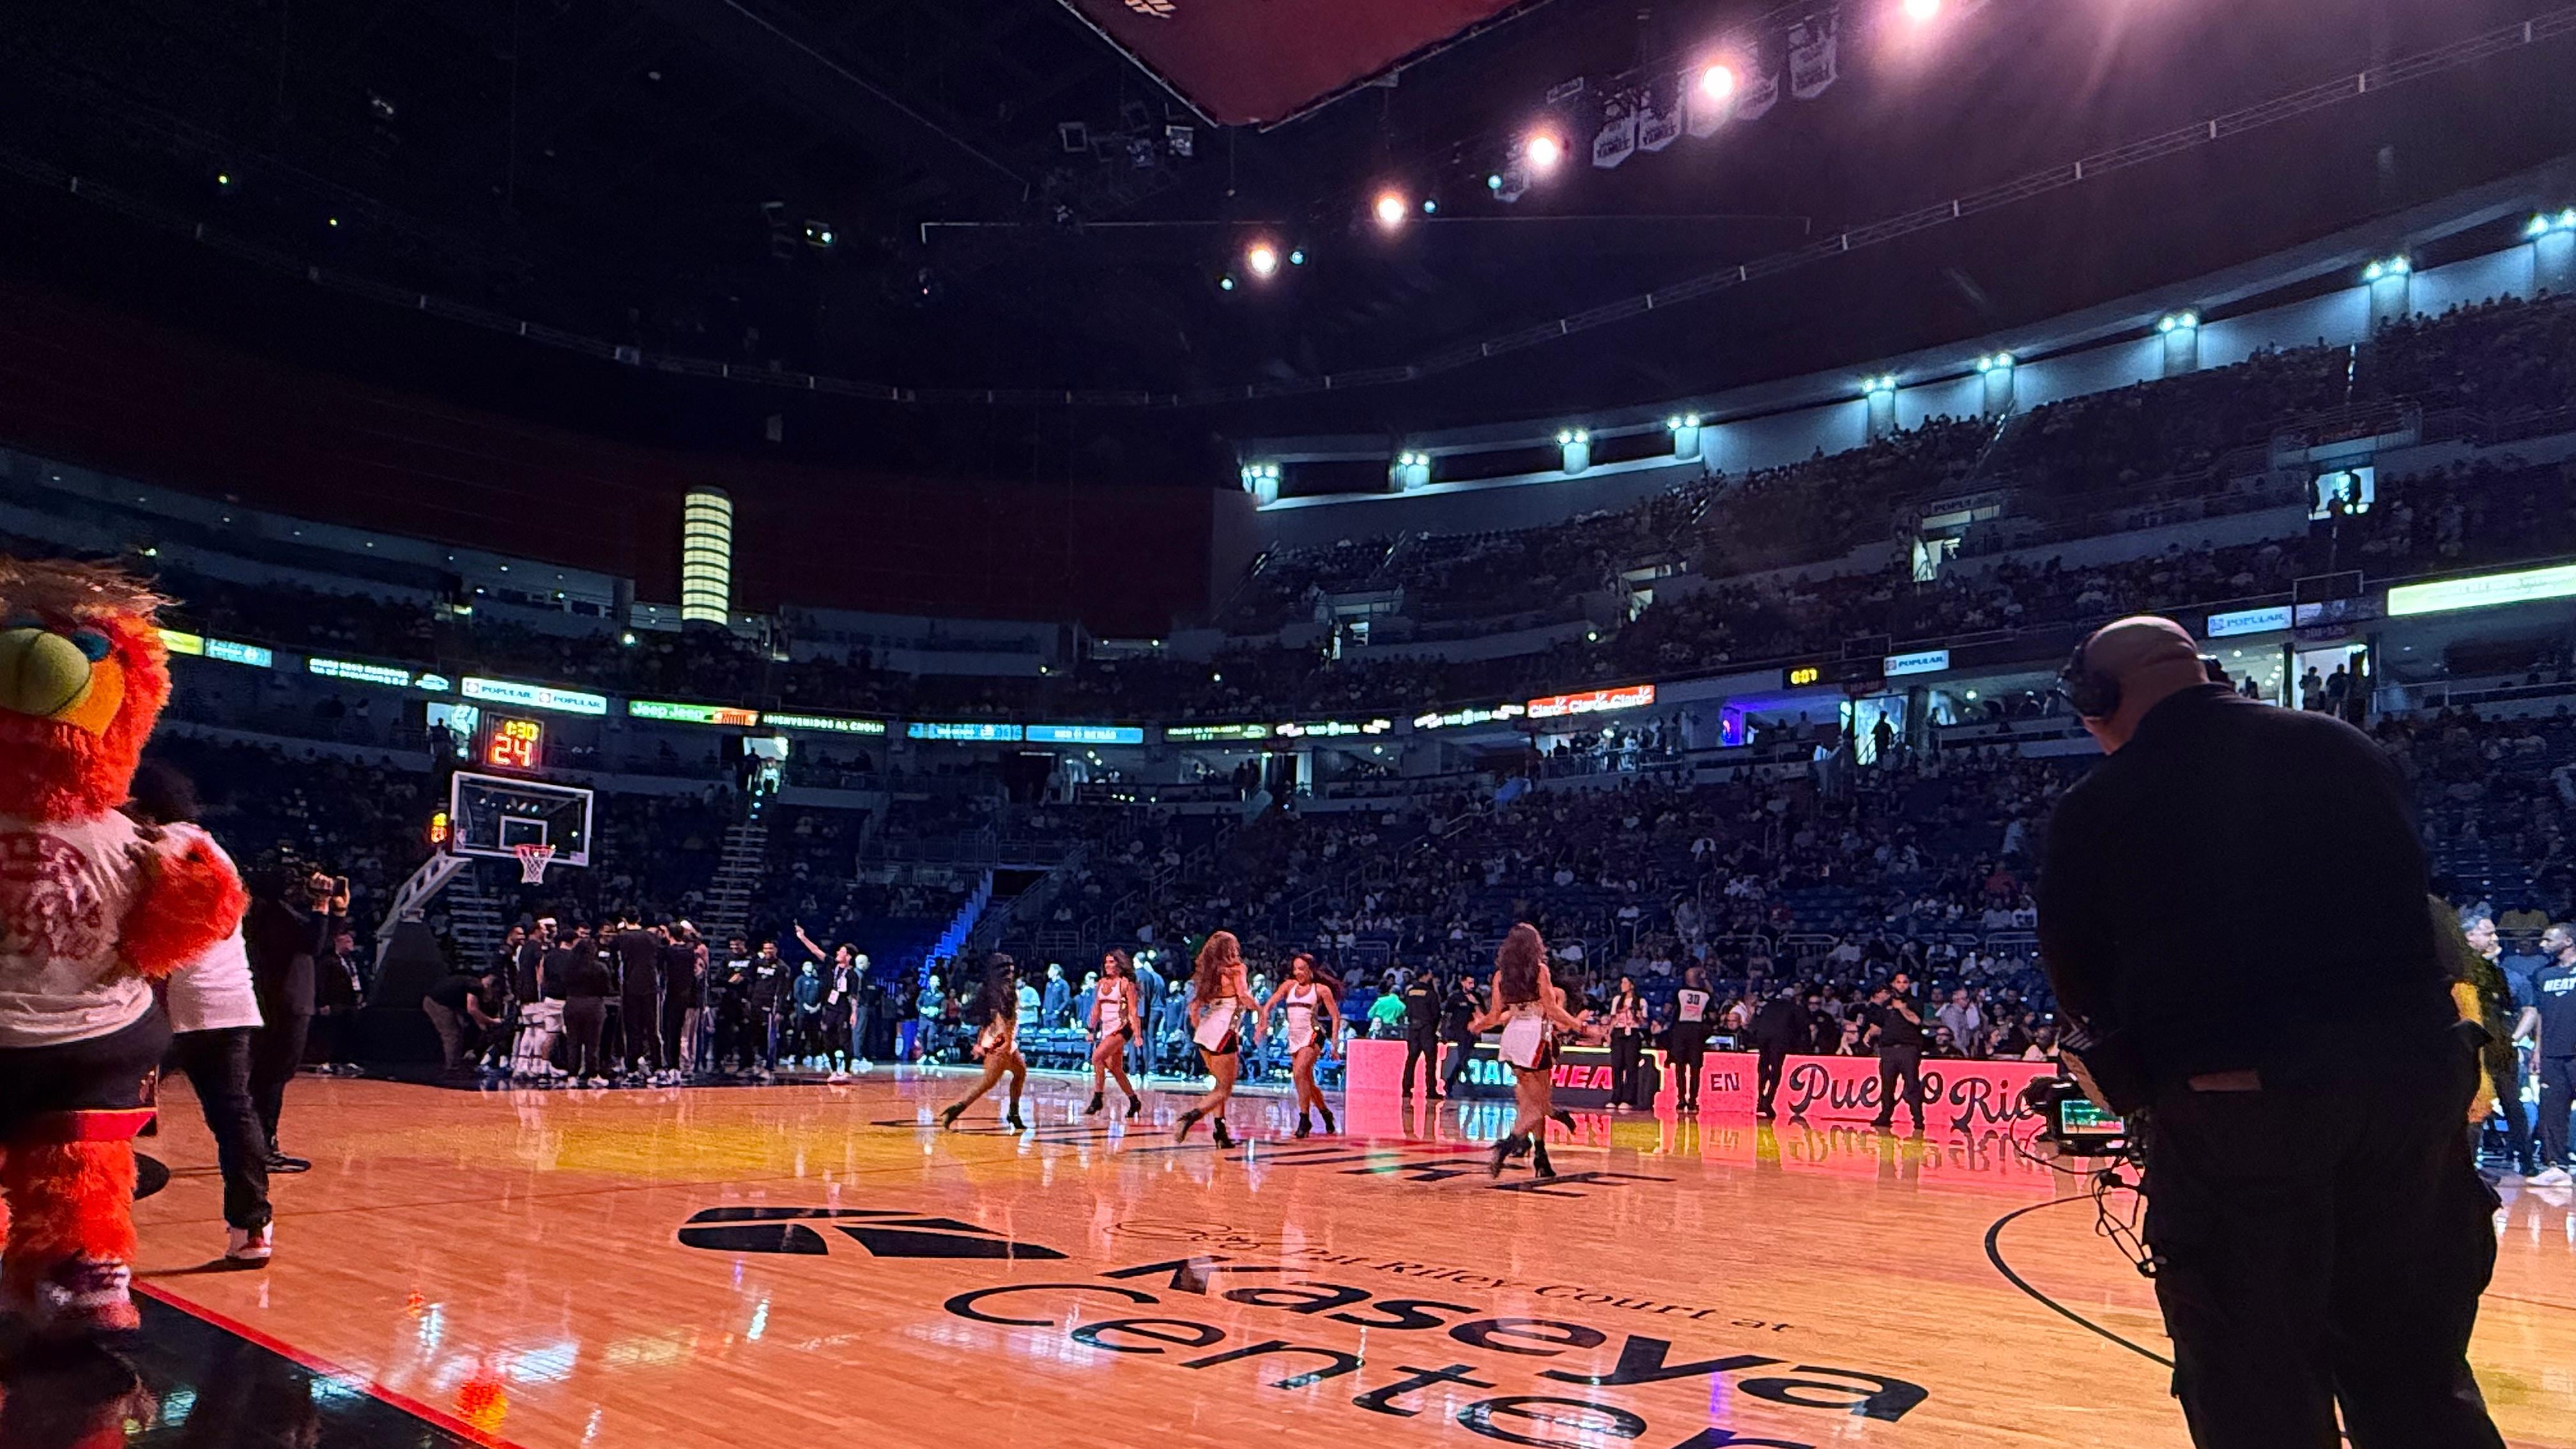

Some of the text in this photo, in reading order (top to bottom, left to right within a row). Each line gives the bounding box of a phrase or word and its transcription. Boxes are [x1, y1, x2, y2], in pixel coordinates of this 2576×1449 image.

[2227, 613, 2285, 627] POPULAR
[1897, 656, 1945, 668] POPULAR
[481, 686, 601, 709] POPULAR POPULAR
[1529, 701, 1562, 718] Claro
[1568, 696, 1602, 714] Claro
[1610, 691, 1646, 709] Claro
[632, 702, 703, 720] Jeep Jeep
[493, 733, 533, 767] 24
[2543, 977, 2576, 992] HEAT
[1710, 1072, 1740, 1092] EN
[1788, 1063, 1943, 1114] Pueo
[1372, 1261, 1505, 1289] Riley
[1534, 1285, 1717, 1320] Court
[1731, 1318, 1795, 1333] at
[1095, 1255, 1930, 1423] Kaseya
